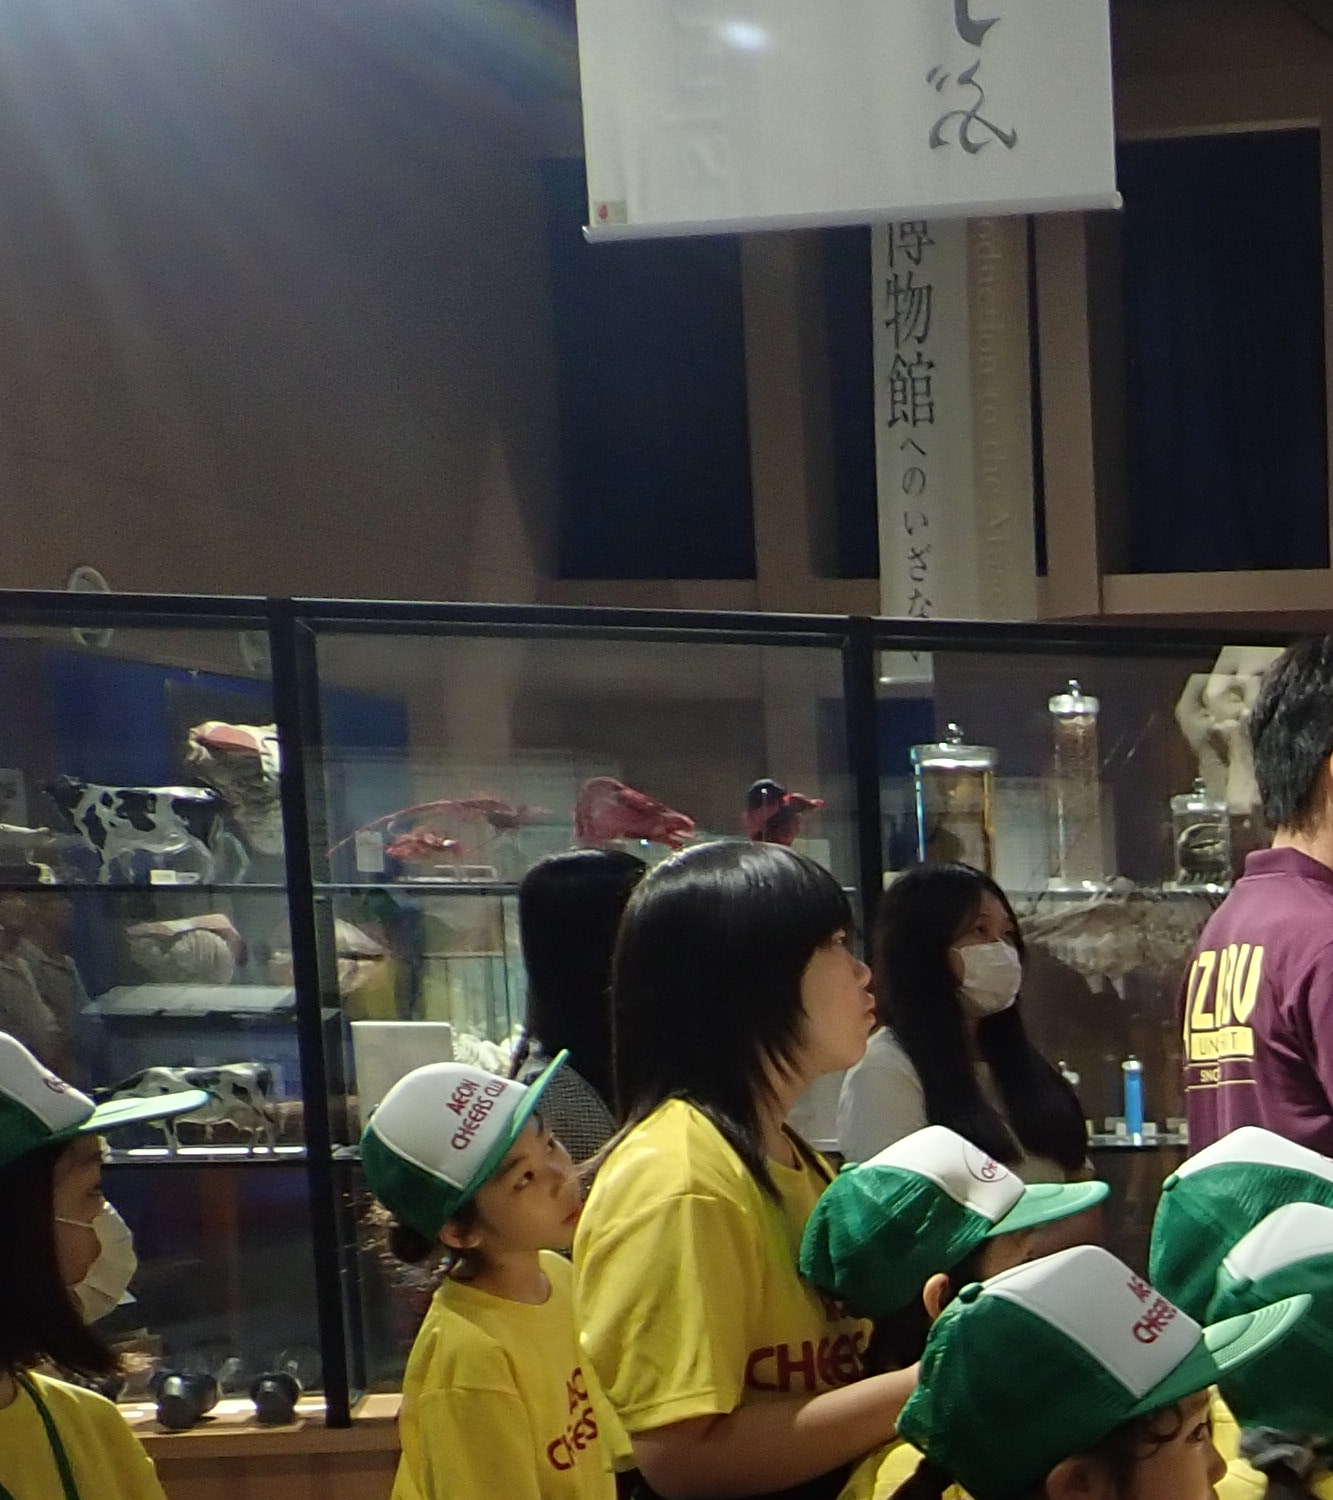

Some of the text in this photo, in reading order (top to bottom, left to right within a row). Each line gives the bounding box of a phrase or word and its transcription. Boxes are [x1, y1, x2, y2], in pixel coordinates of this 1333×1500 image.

[885, 220, 936, 664] 博物館へのいざな
[450, 1096, 494, 1150] CHEERS
